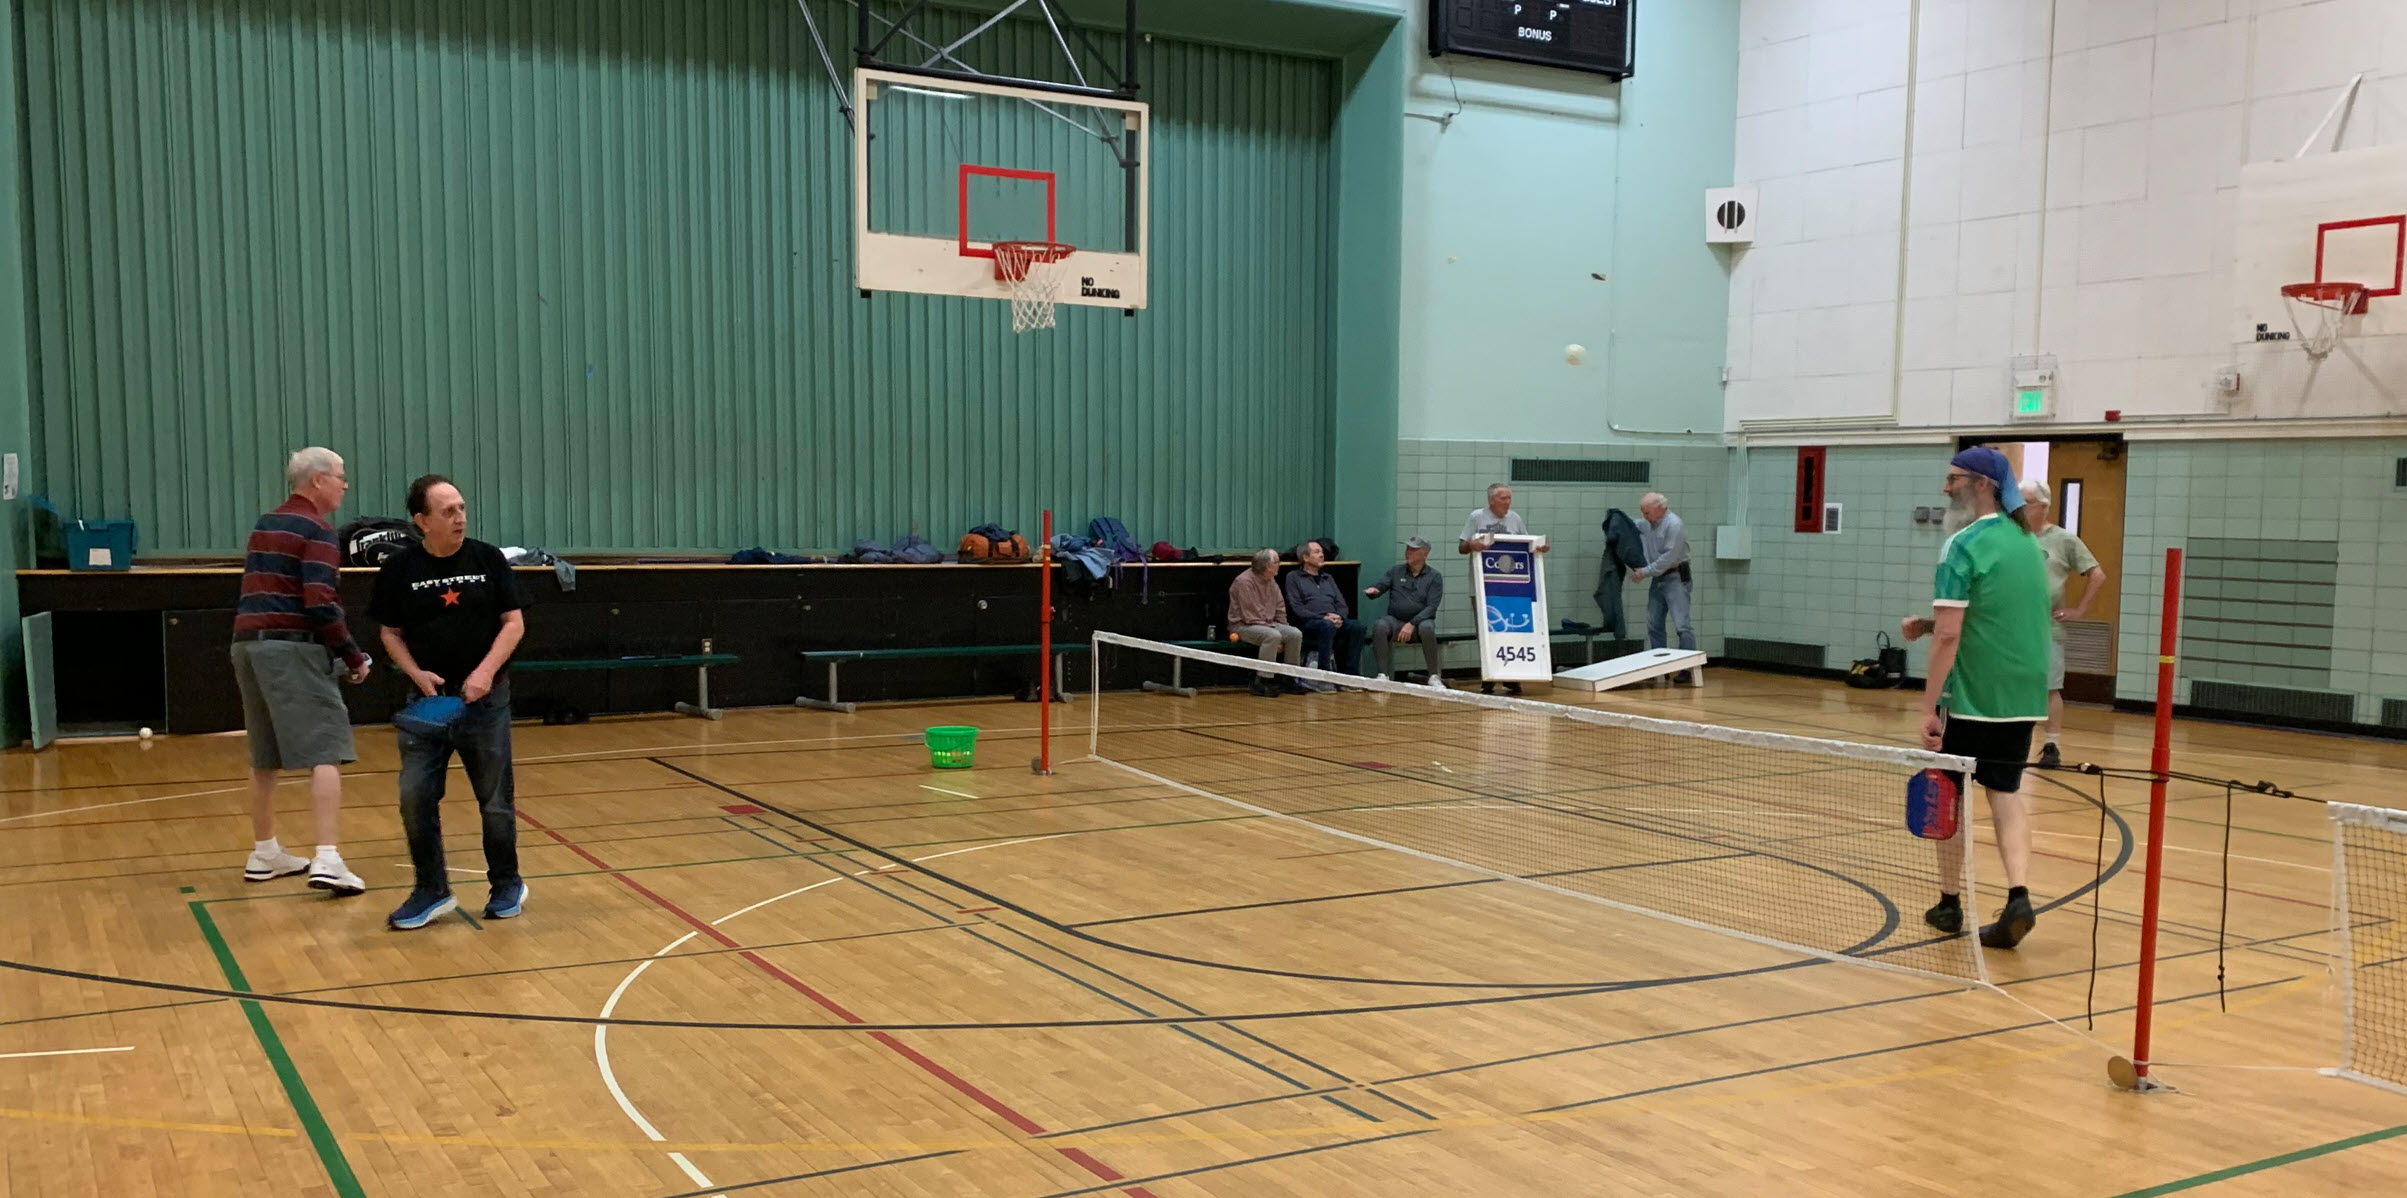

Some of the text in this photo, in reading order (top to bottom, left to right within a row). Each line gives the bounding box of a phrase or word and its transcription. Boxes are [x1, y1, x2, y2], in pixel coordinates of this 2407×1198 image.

[1514, 4, 1558, 20] P P
[1518, 26, 1552, 41] BONUS
[1081, 276, 1094, 287] NO
[1081, 287, 1120, 299] DUNKING
[2256, 323, 2267, 332] NO
[2256, 332, 2290, 341] DUNKING
[1496, 646, 1536, 662] 4545
